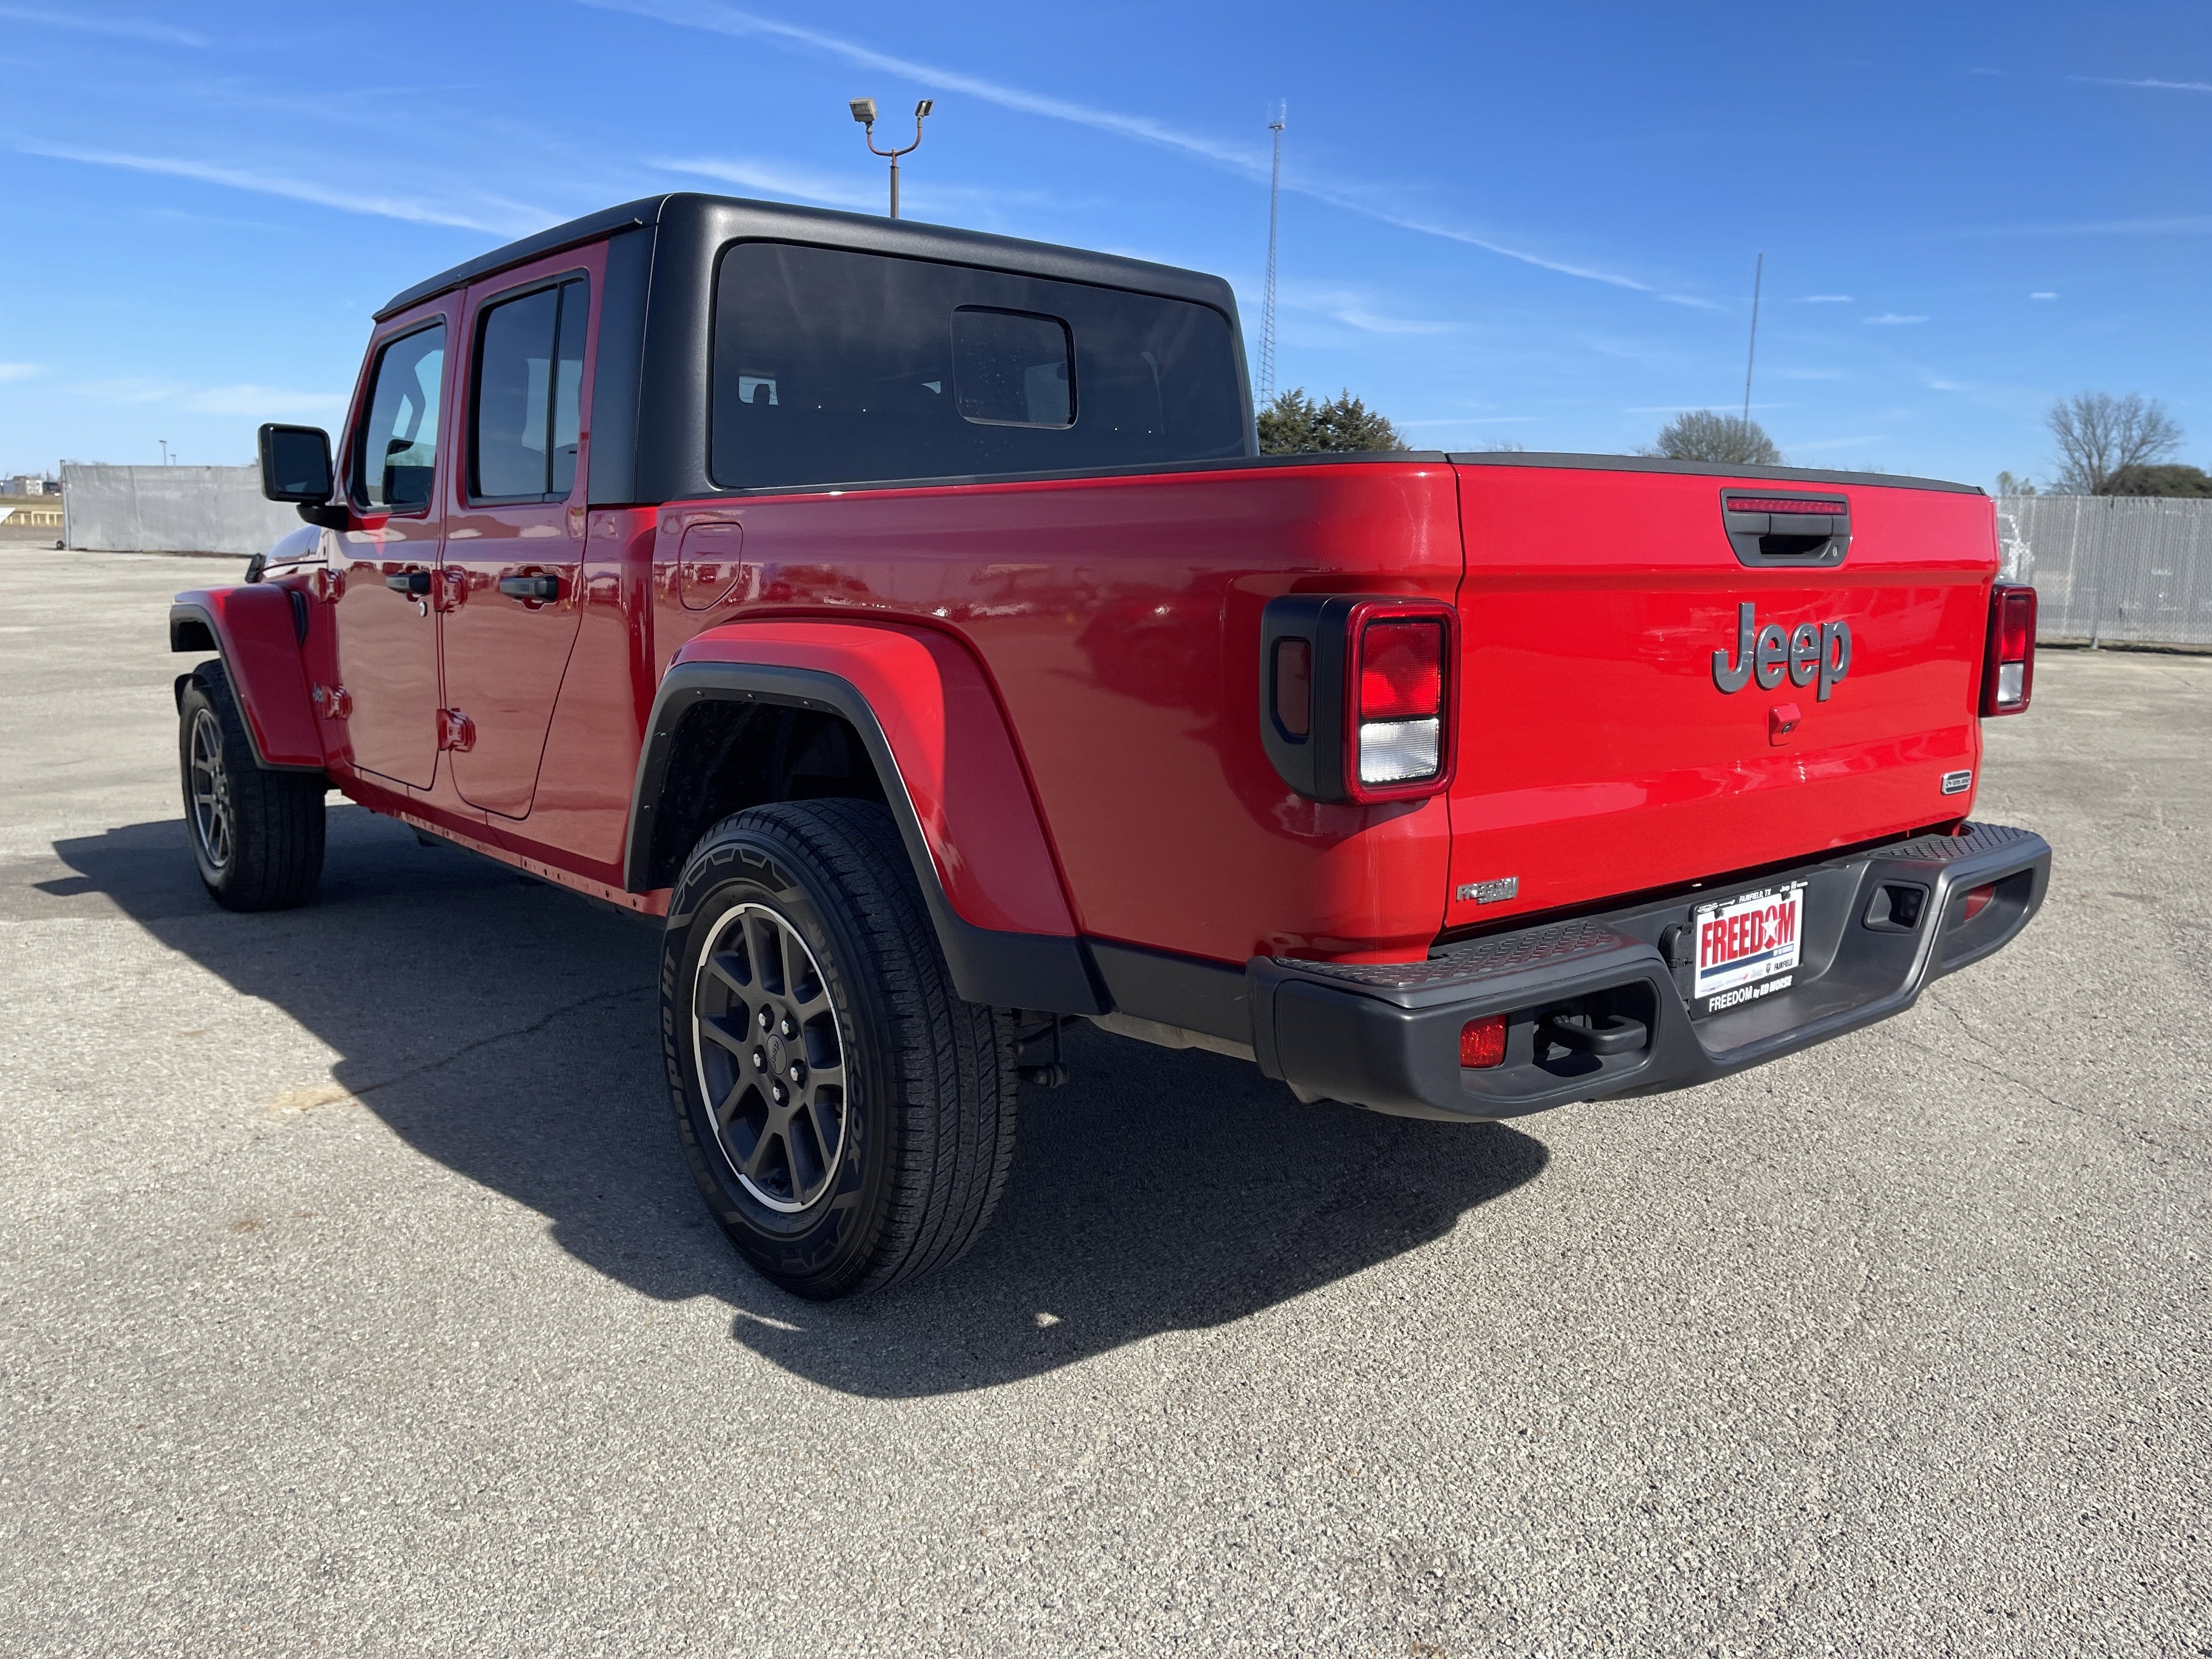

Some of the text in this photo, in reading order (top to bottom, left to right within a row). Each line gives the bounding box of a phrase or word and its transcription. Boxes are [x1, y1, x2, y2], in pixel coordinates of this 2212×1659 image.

[1712, 602, 1852, 702] Jeep
[1765, 888, 1771, 896] TX
[1701, 900, 1797, 968] FREEDOM
[1709, 986, 1753, 1012] FREEDOM
[1759, 983, 1770, 996] ED
[1769, 975, 1793, 992] MORSE
